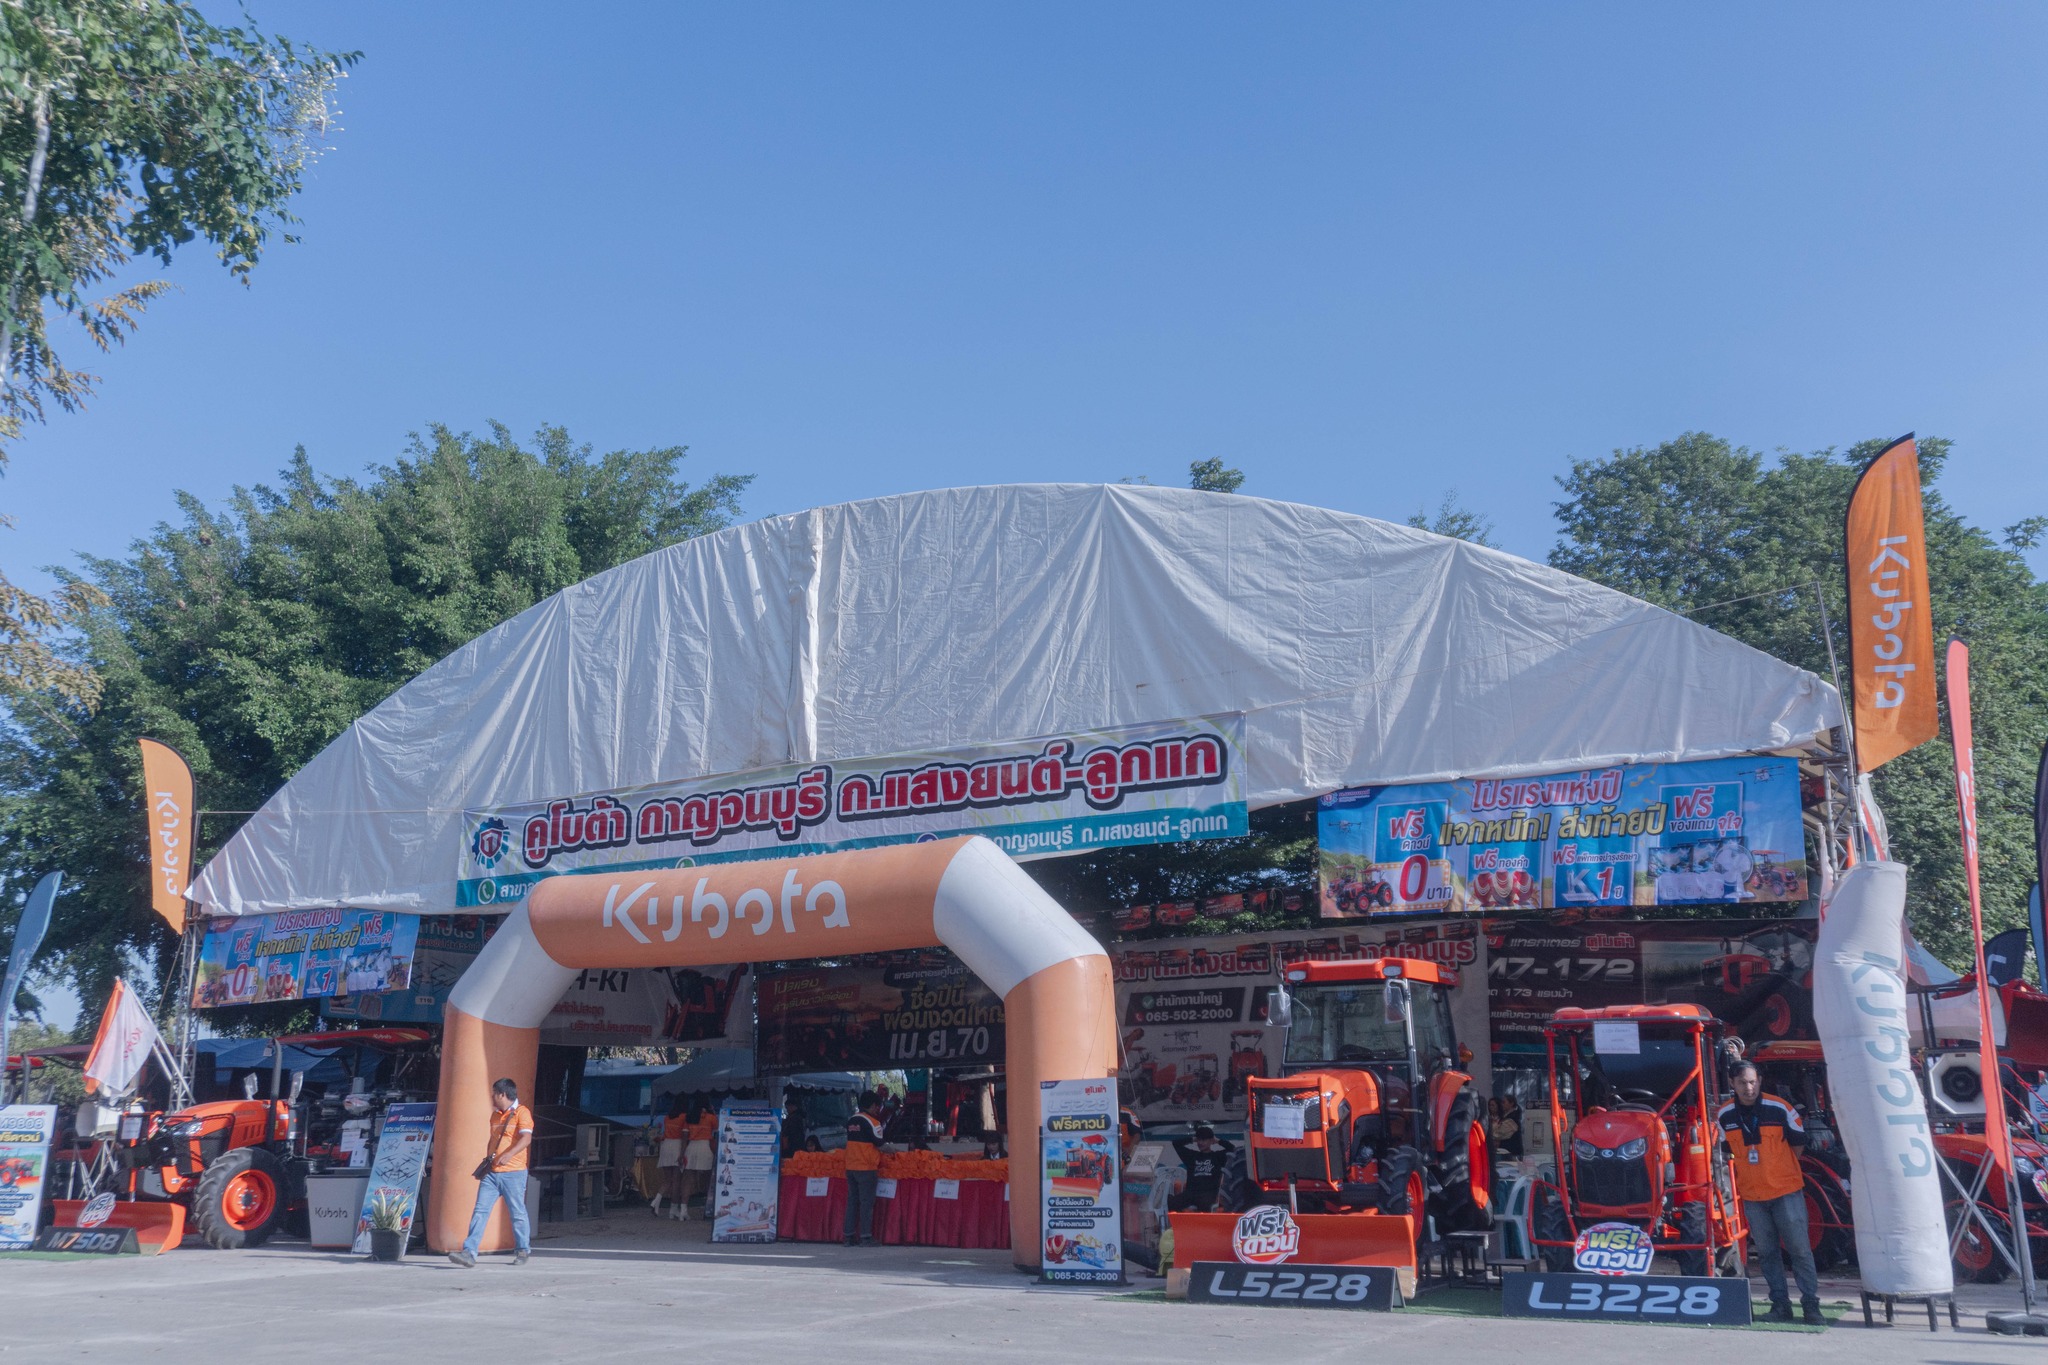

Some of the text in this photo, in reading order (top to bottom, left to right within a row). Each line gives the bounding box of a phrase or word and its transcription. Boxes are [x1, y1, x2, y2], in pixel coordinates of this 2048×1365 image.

[1868, 535, 1916, 709] Kubota
[525, 738, 1220, 861] คูโบต้า กาญจนบุรี ก.แสงยนต์-ลูกแก
[1472, 769, 1624, 813] โปรแรงแห่งปี
[1673, 786, 1715, 820] ฟรี
[994, 825, 1074, 853] กาญจนบุรี
[1082, 815, 1228, 844] ก.แสงยนต์-ลูกแก
[1390, 807, 1426, 839] ฟรี
[1437, 803, 1668, 847] แจกหนัก! ส่งท้ายปี
[1670, 819, 1715, 832] ของแถม
[1402, 835, 1431, 850] ดาวน์
[1552, 845, 1577, 865] ฟรี
[1474, 848, 1529, 869] ฟรี ทองคำ
[1399, 854, 1453, 902] 0 บาท
[1597, 867, 1624, 899] 1 ปี
[603, 869, 851, 944] Kubota
[363, 913, 384, 936] ฟรี
[235, 931, 254, 953] ฟรี
[1510, 934, 1582, 948] แทรกเตอร์
[1585, 931, 1636, 952] คูโบต้า
[232, 963, 249, 997] 0
[1504, 988, 1533, 998] 173
[1537, 987, 1574, 998] แรงม้า
[1156, 990, 1224, 1008] สำนักงานใหญ่
[1145, 1007, 1234, 1022] 065-502-2000
[1851, 949, 1933, 1179] Kubota
[1047, 1098, 1110, 1114] L5228
[1052, 1114, 1106, 1131] ฟรีดาวน์
[314, 1206, 348, 1219] Kubota
[1239, 1207, 1289, 1239] ฟรี!
[46, 1231, 121, 1250] M7508
[1242, 1229, 1298, 1257] ดาวน์
[1587, 1228, 1639, 1251] ฟรี!
[1577, 1245, 1651, 1272] ดาวน์
[1054, 1271, 1118, 1281] 065-502-2000
[1209, 1270, 1371, 1301] L5228
[1528, 1281, 1721, 1316] L3228
